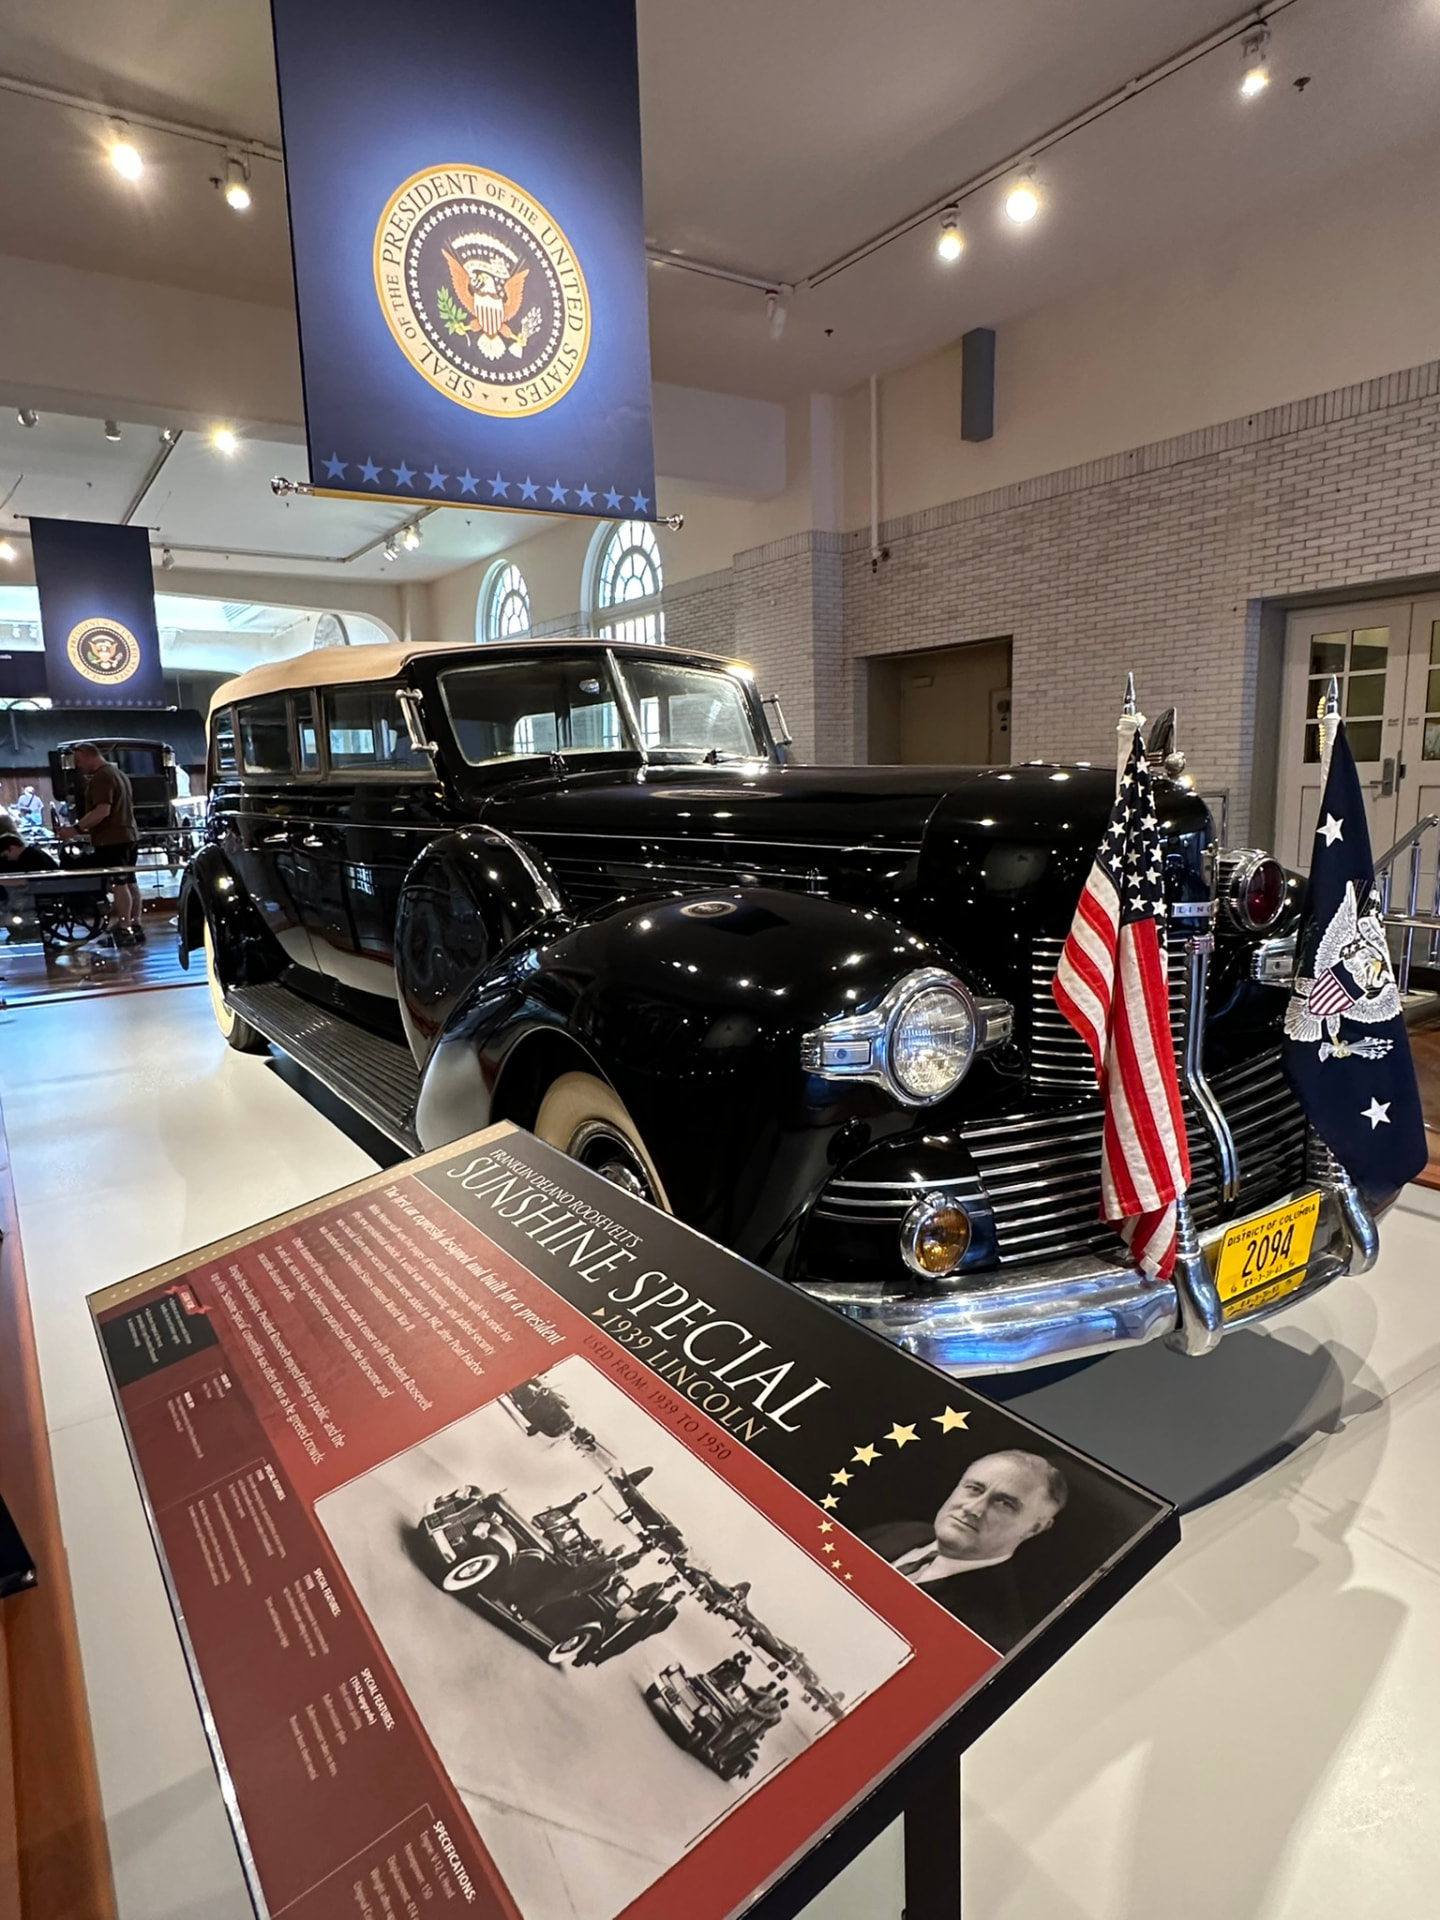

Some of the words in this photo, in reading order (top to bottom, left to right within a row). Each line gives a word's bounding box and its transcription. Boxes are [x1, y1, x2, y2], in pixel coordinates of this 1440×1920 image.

[486, 183, 506, 201] OF
[383, 174, 478, 266] PRESIDENT
[510, 194, 539, 226] THE
[387, 274, 406, 314] THE
[541, 227, 583, 331] UNITED
[397, 317, 416, 340] OF
[418, 342, 475, 398] SEAL
[514, 342, 578, 407] STATES
[488, 1148, 538, 1179] FRANKLIN
[528, 1174, 575, 1204] DELANO
[567, 1199, 643, 1248] ROOSEVELT'S
[1227, 1225, 1265, 1247] DISTRICT
[1266, 1220, 1278, 1230] OF
[1280, 1203, 1316, 1226] COLUMBIA
[437, 1235, 478, 1264] designed
[1242, 1224, 1295, 1278] 2094
[464, 1261, 492, 1277] and
[479, 1272, 508, 1293] built
[443, 1155, 637, 1283] SUNSHINE
[607, 1270, 831, 1432] SPECIAL
[494, 1287, 518, 1303] for
[509, 1302, 525, 1311] a
[513, 1307, 566, 1345] president
[375, 1383, 395, 1398] and
[600, 1314, 653, 1349] 1939
[645, 1348, 767, 1441] LINCOLN
[283, 1402, 297, 1415] he
[305, 1391, 318, 1402] in
[403, 1378, 433, 1410] Roosevelt
[582, 1334, 614, 1360] USED
[646, 1389, 679, 1414] 1939
[675, 1413, 699, 1432] TO
[696, 1431, 732, 1460] 1950
[286, 1413, 313, 1440] greeted
[322, 1421, 341, 1437] and
[330, 1433, 345, 1448] the
[312, 1567, 328, 1590] SPECIAL
[360, 1667, 378, 1696] SPECIAL
[372, 1692, 395, 1730] FEATURES:
[432, 1819, 476, 1903] SPECIFICATIONS:
